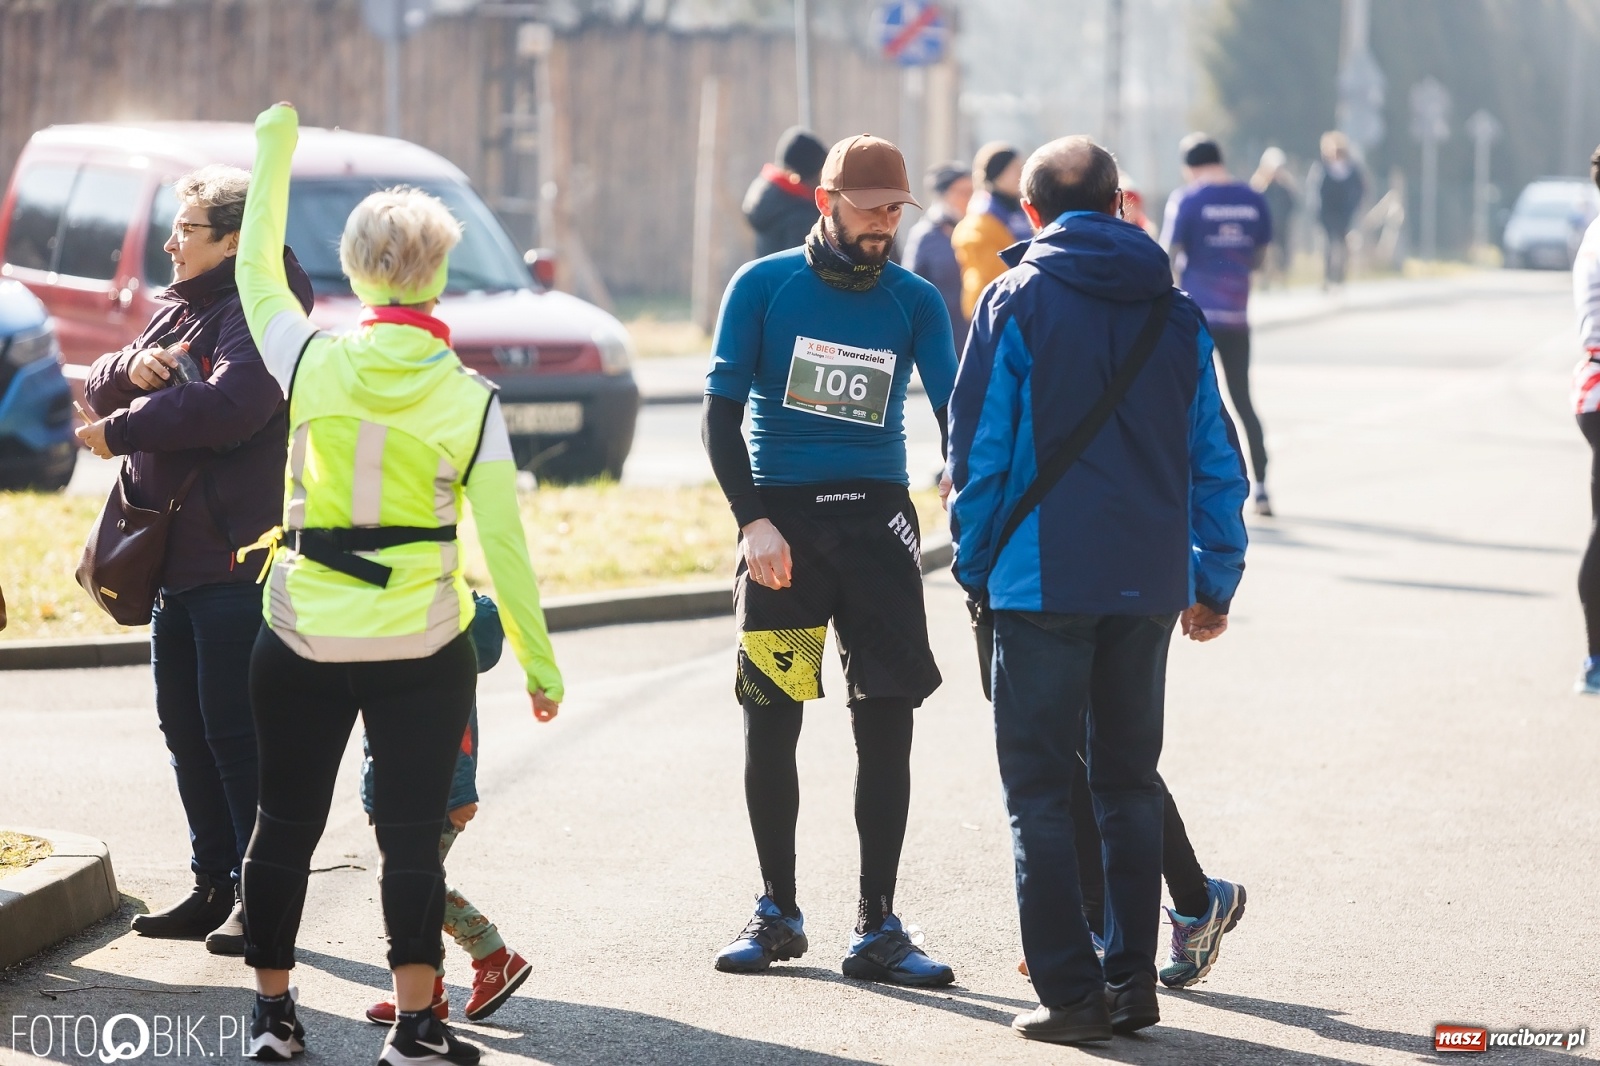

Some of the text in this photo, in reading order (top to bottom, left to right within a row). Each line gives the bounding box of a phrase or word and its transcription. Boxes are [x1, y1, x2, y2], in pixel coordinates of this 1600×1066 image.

[808, 342, 814, 350] X
[816, 344, 836, 354] BIEG
[837, 348, 885, 364] Twardziela
[814, 365, 869, 401] 106
[815, 492, 866, 503] SMMASH
[482, 970, 501, 984] N
